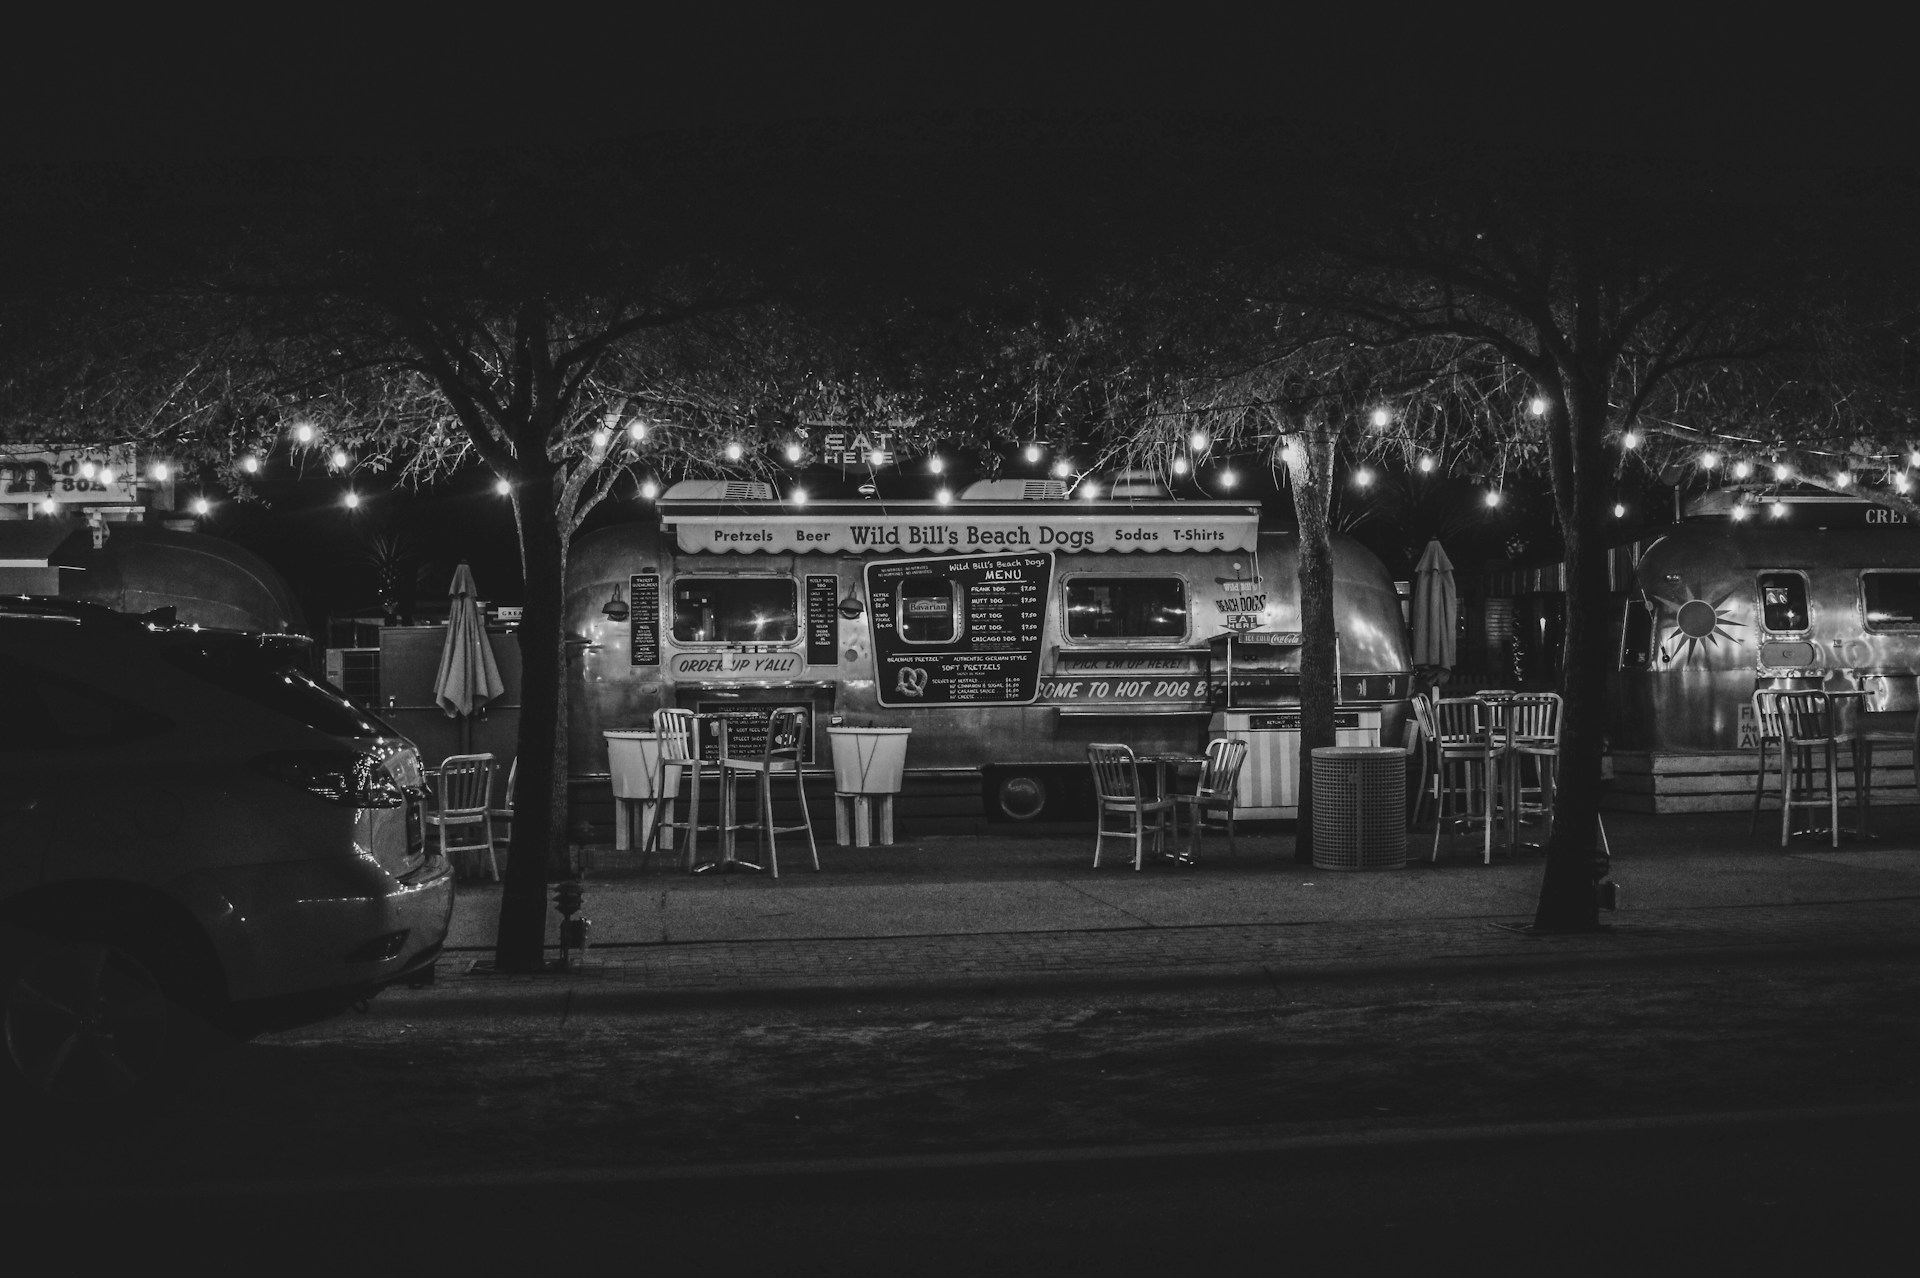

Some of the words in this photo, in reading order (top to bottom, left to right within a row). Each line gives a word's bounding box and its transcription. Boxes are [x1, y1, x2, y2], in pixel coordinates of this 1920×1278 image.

[825, 434, 892, 450] EAT
[714, 530, 773, 542] Pretzels
[796, 531, 830, 542] Beer
[850, 526, 900, 545] Wild
[909, 526, 959, 545] Bill's
[967, 526, 1031, 545] Beach
[1039, 526, 1094, 548] Dogs
[1115, 529, 1158, 541] Sodas
[1173, 529, 1225, 541] T-Shirts
[949, 562, 970, 571] Wild
[972, 561, 993, 570] Bill's
[996, 560, 1021, 568] Beach
[1025, 559, 1045, 567] Dogs
[985, 569, 1022, 580] MENU
[910, 602, 946, 611] Bavarian
[1216, 598, 1240, 612] BEACH
[1240, 594, 1266, 612] DOGS
[680, 660, 723, 672] ORDER
[730, 660, 750, 671] UP
[755, 658, 795, 671] Y'ALL!
[1073, 658, 1098, 669] PICK
[1128, 659, 1144, 669] UP
[1148, 658, 1182, 669] HERE!
[1088, 681, 1109, 698] TO
[1114, 681, 1151, 698] HOT
[1154, 681, 1190, 698] DOG
